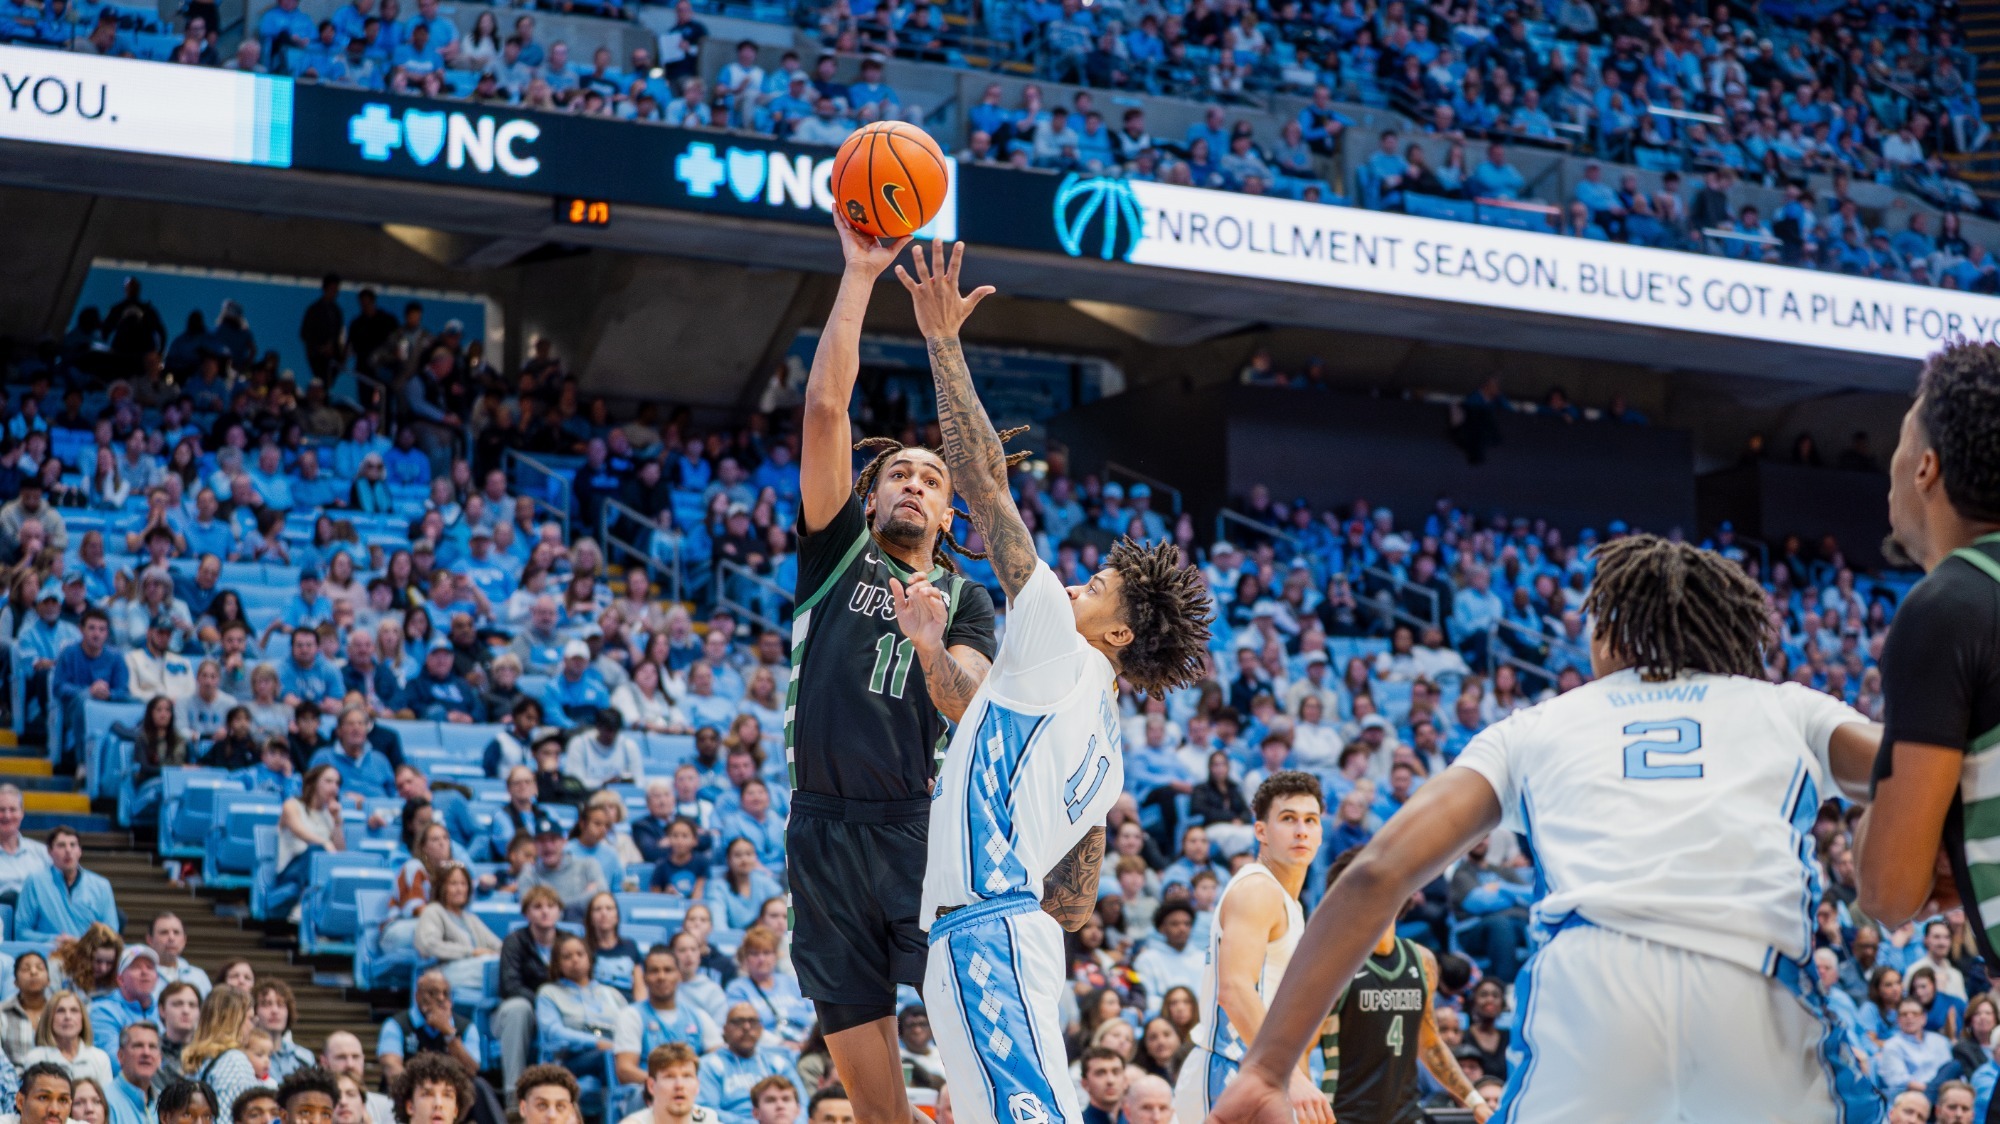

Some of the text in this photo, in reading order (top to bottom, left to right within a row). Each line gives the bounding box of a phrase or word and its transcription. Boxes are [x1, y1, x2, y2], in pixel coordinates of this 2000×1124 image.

[1, 73, 119, 122] YOU.
[447, 112, 541, 178] NC
[1414, 241, 1568, 292] SEASON.
[1579, 263, 1692, 307] BLUE'S
[1703, 279, 1770, 316] GOT
[1781, 291, 1802, 322] A
[1811, 294, 1892, 332] PLAN
[1904, 306, 1963, 340] FOR
[849, 582, 898, 621] UPS
[869, 633, 914, 699] 11
[1606, 685, 1709, 708] BROWN
[1623, 717, 1704, 780] 2
[1064, 734, 1110, 825] 11
[1360, 988, 1423, 1012] UPSTATE
[1386, 1014, 1404, 1057] 4
